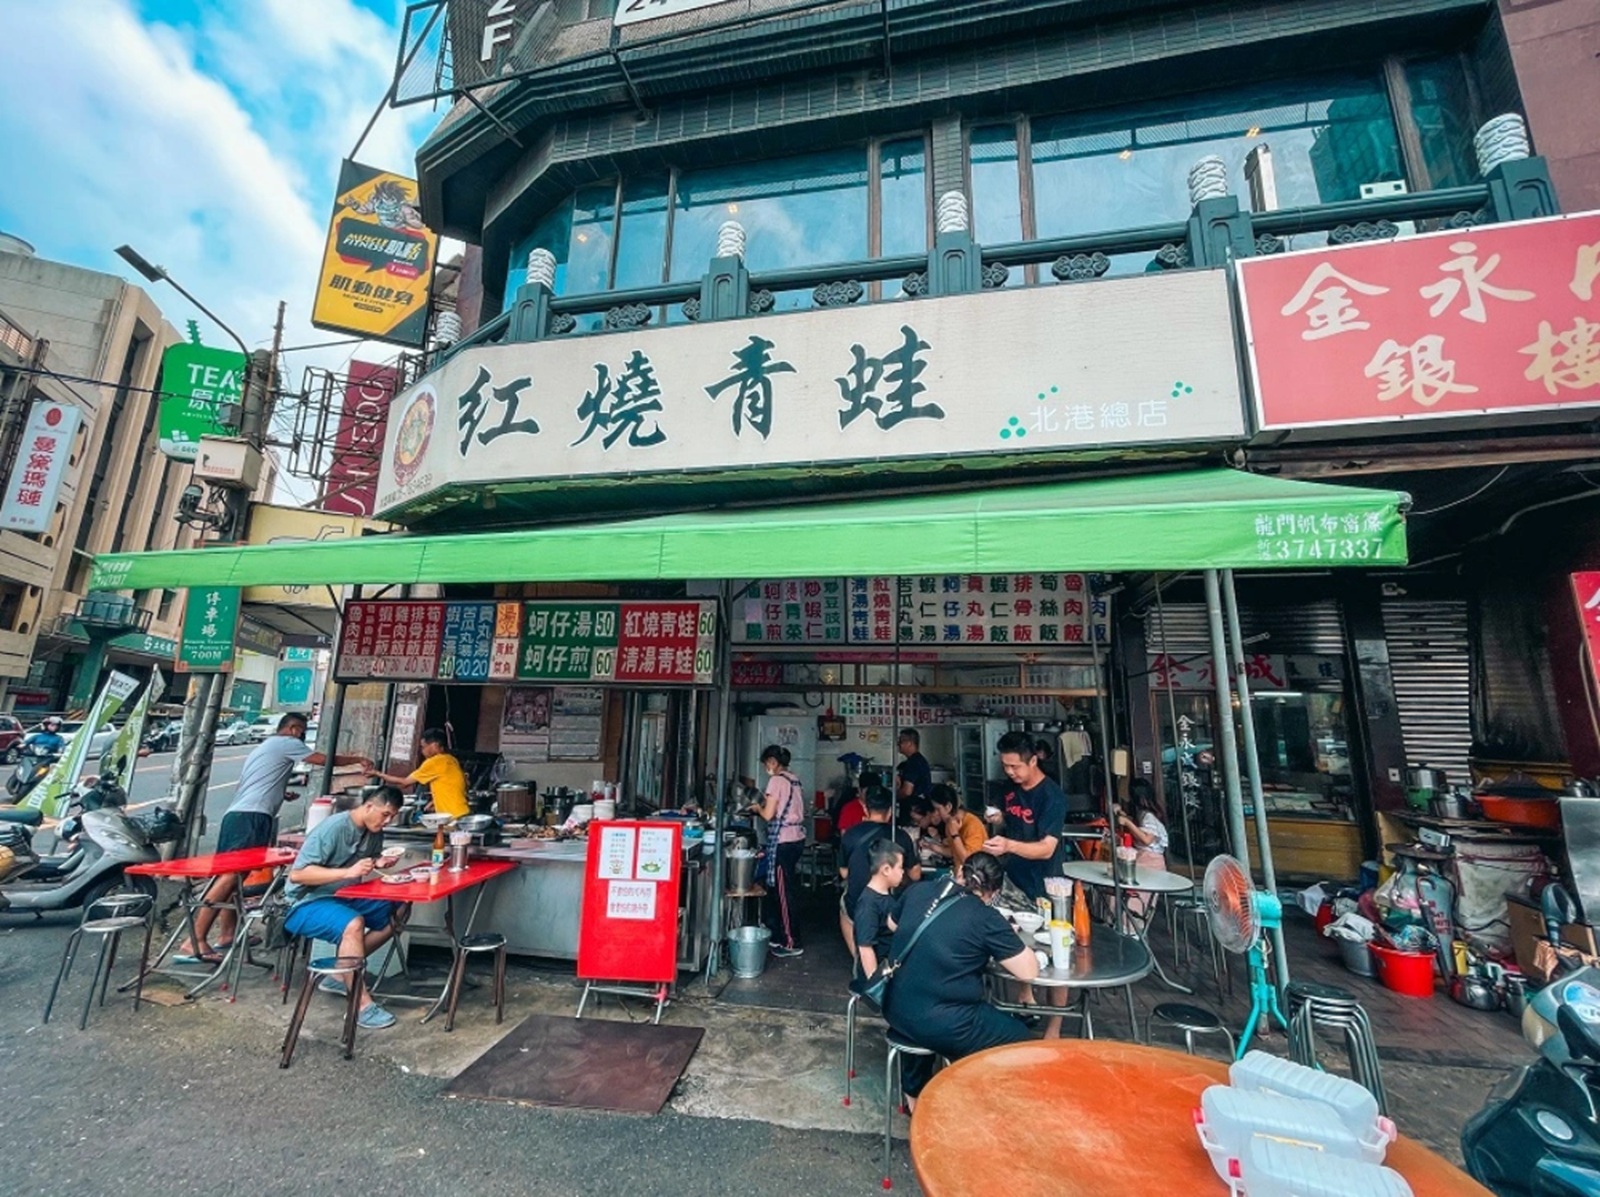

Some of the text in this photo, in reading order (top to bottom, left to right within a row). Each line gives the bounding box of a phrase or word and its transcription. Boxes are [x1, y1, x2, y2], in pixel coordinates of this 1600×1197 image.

[1281, 241, 1600, 341] 金永
[457, 325, 945, 458] 紅燒青蛙
[1029, 400, 1168, 433] 北港總店
[1276, 538, 1383, 559] 3747337
[201, 591, 221, 637] 停車場
[405, 606, 426, 655] 排骨飯
[422, 606, 442, 655] 筍絲飯
[527, 611, 592, 638] 蚵仔湯
[623, 611, 715, 638] 紅燒青蛙 60
[765, 583, 782, 640] 蚵仔煎
[805, 581, 823, 640] 炒蝦仁
[852, 578, 869, 640] 清湯青蛙
[873, 577, 891, 640] 紅燒青蛙
[897, 578, 914, 641] 苦瓜丸湯
[919, 577, 937, 641] 蝦仁湯
[943, 576, 960, 641] 蚵仔湯
[966, 576, 984, 641] 貢丸湯
[990, 577, 1008, 642] 蝦仁飯
[1014, 575, 1033, 642] 排骨飯
[1039, 575, 1059, 642] 筍絲飯
[1063, 575, 1083, 642] 魯肉飯
[191, 651, 222, 660] 700M
[456, 607, 478, 676] 苦瓜丸湯 20
[472, 606, 494, 676] 貢丸湯 20
[524, 644, 591, 673] 蚵仔煎
[597, 652, 611, 673] 60
[621, 646, 712, 674] 清湯青蛙 60
